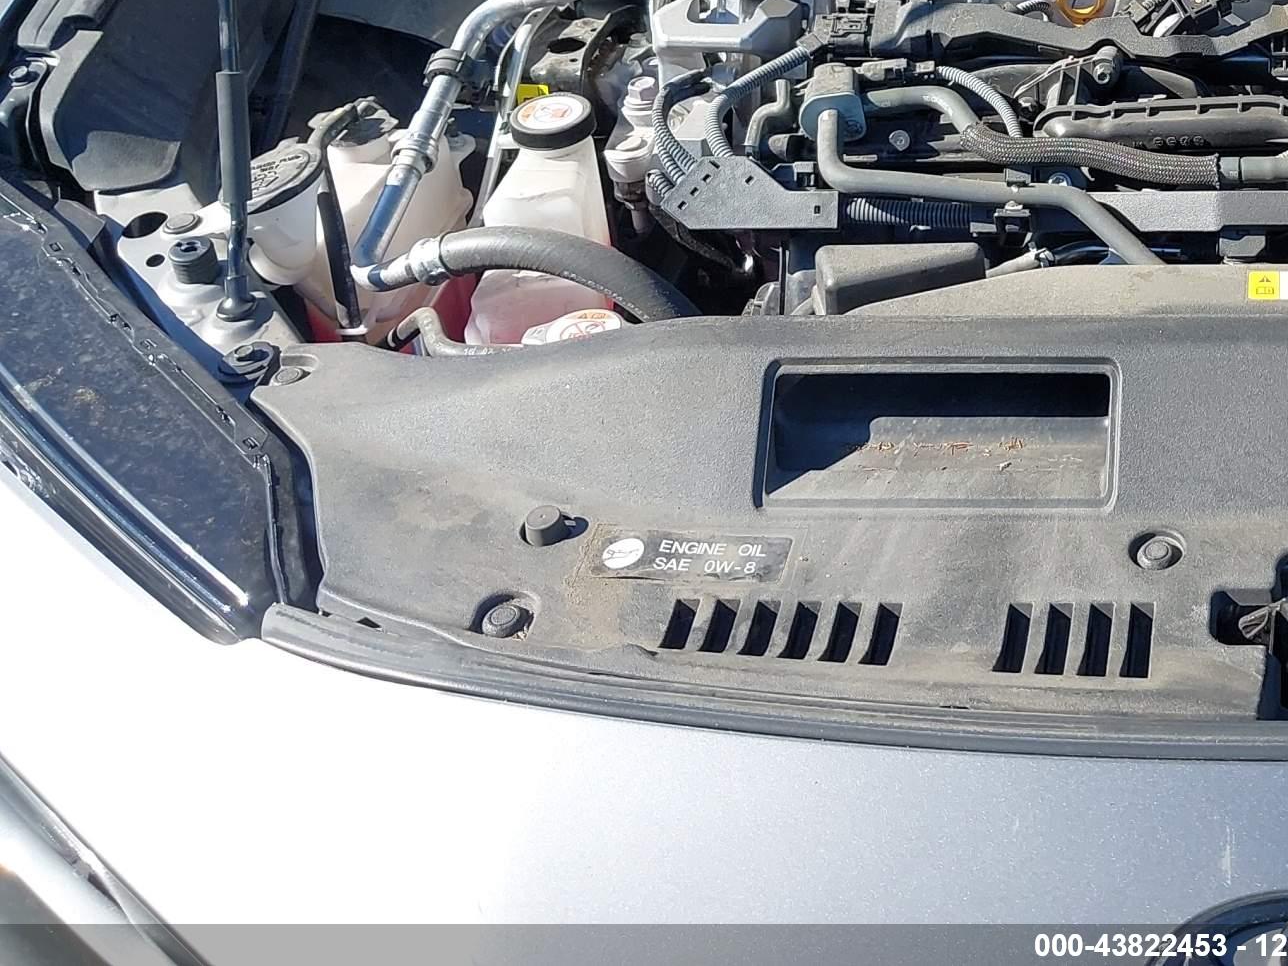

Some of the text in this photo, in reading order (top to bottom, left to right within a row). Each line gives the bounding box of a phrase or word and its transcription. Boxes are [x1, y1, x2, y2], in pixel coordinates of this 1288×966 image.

[659, 539, 766, 557] ENGINE OIL
[653, 557, 756, 574] SAE 0W-8
